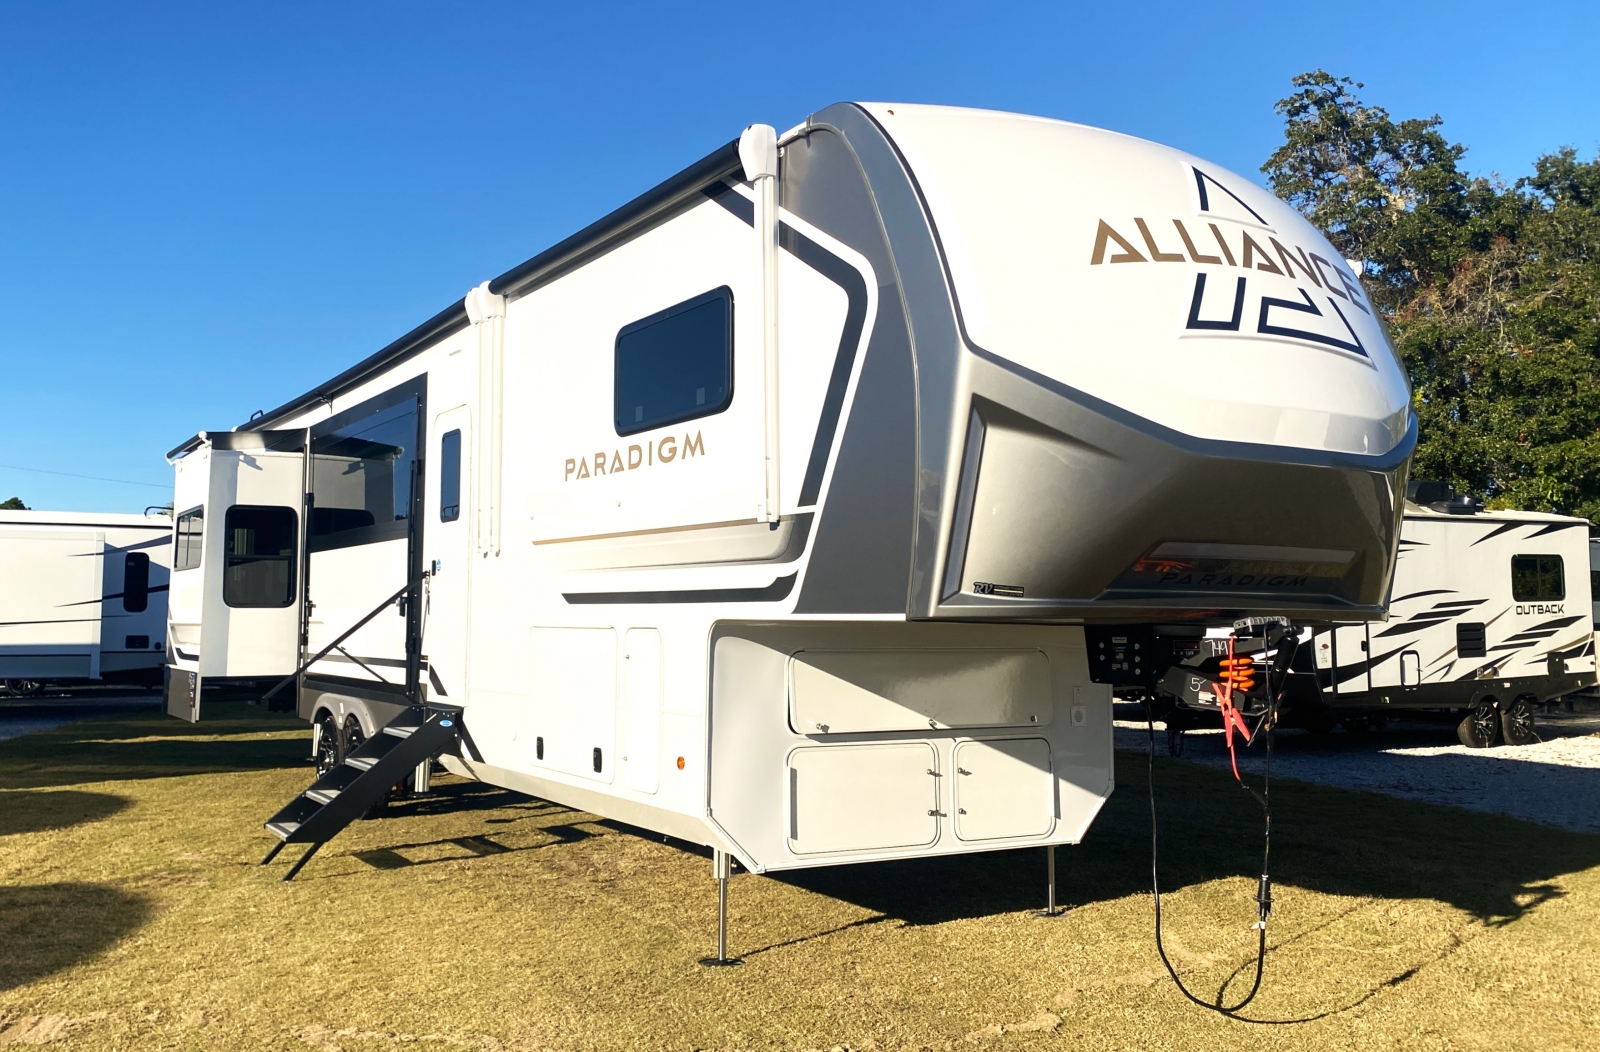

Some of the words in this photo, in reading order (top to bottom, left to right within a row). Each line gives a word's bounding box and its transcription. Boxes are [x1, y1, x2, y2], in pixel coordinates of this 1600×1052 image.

[1090, 217, 1370, 315] ALLIANCE
[565, 429, 705, 482] PARADIGM
[1159, 572, 1308, 587] PARADIGM
[973, 582, 993, 595] RV
[1516, 604, 1565, 615] OUTBACK
[1204, 639, 1229, 657] 749
